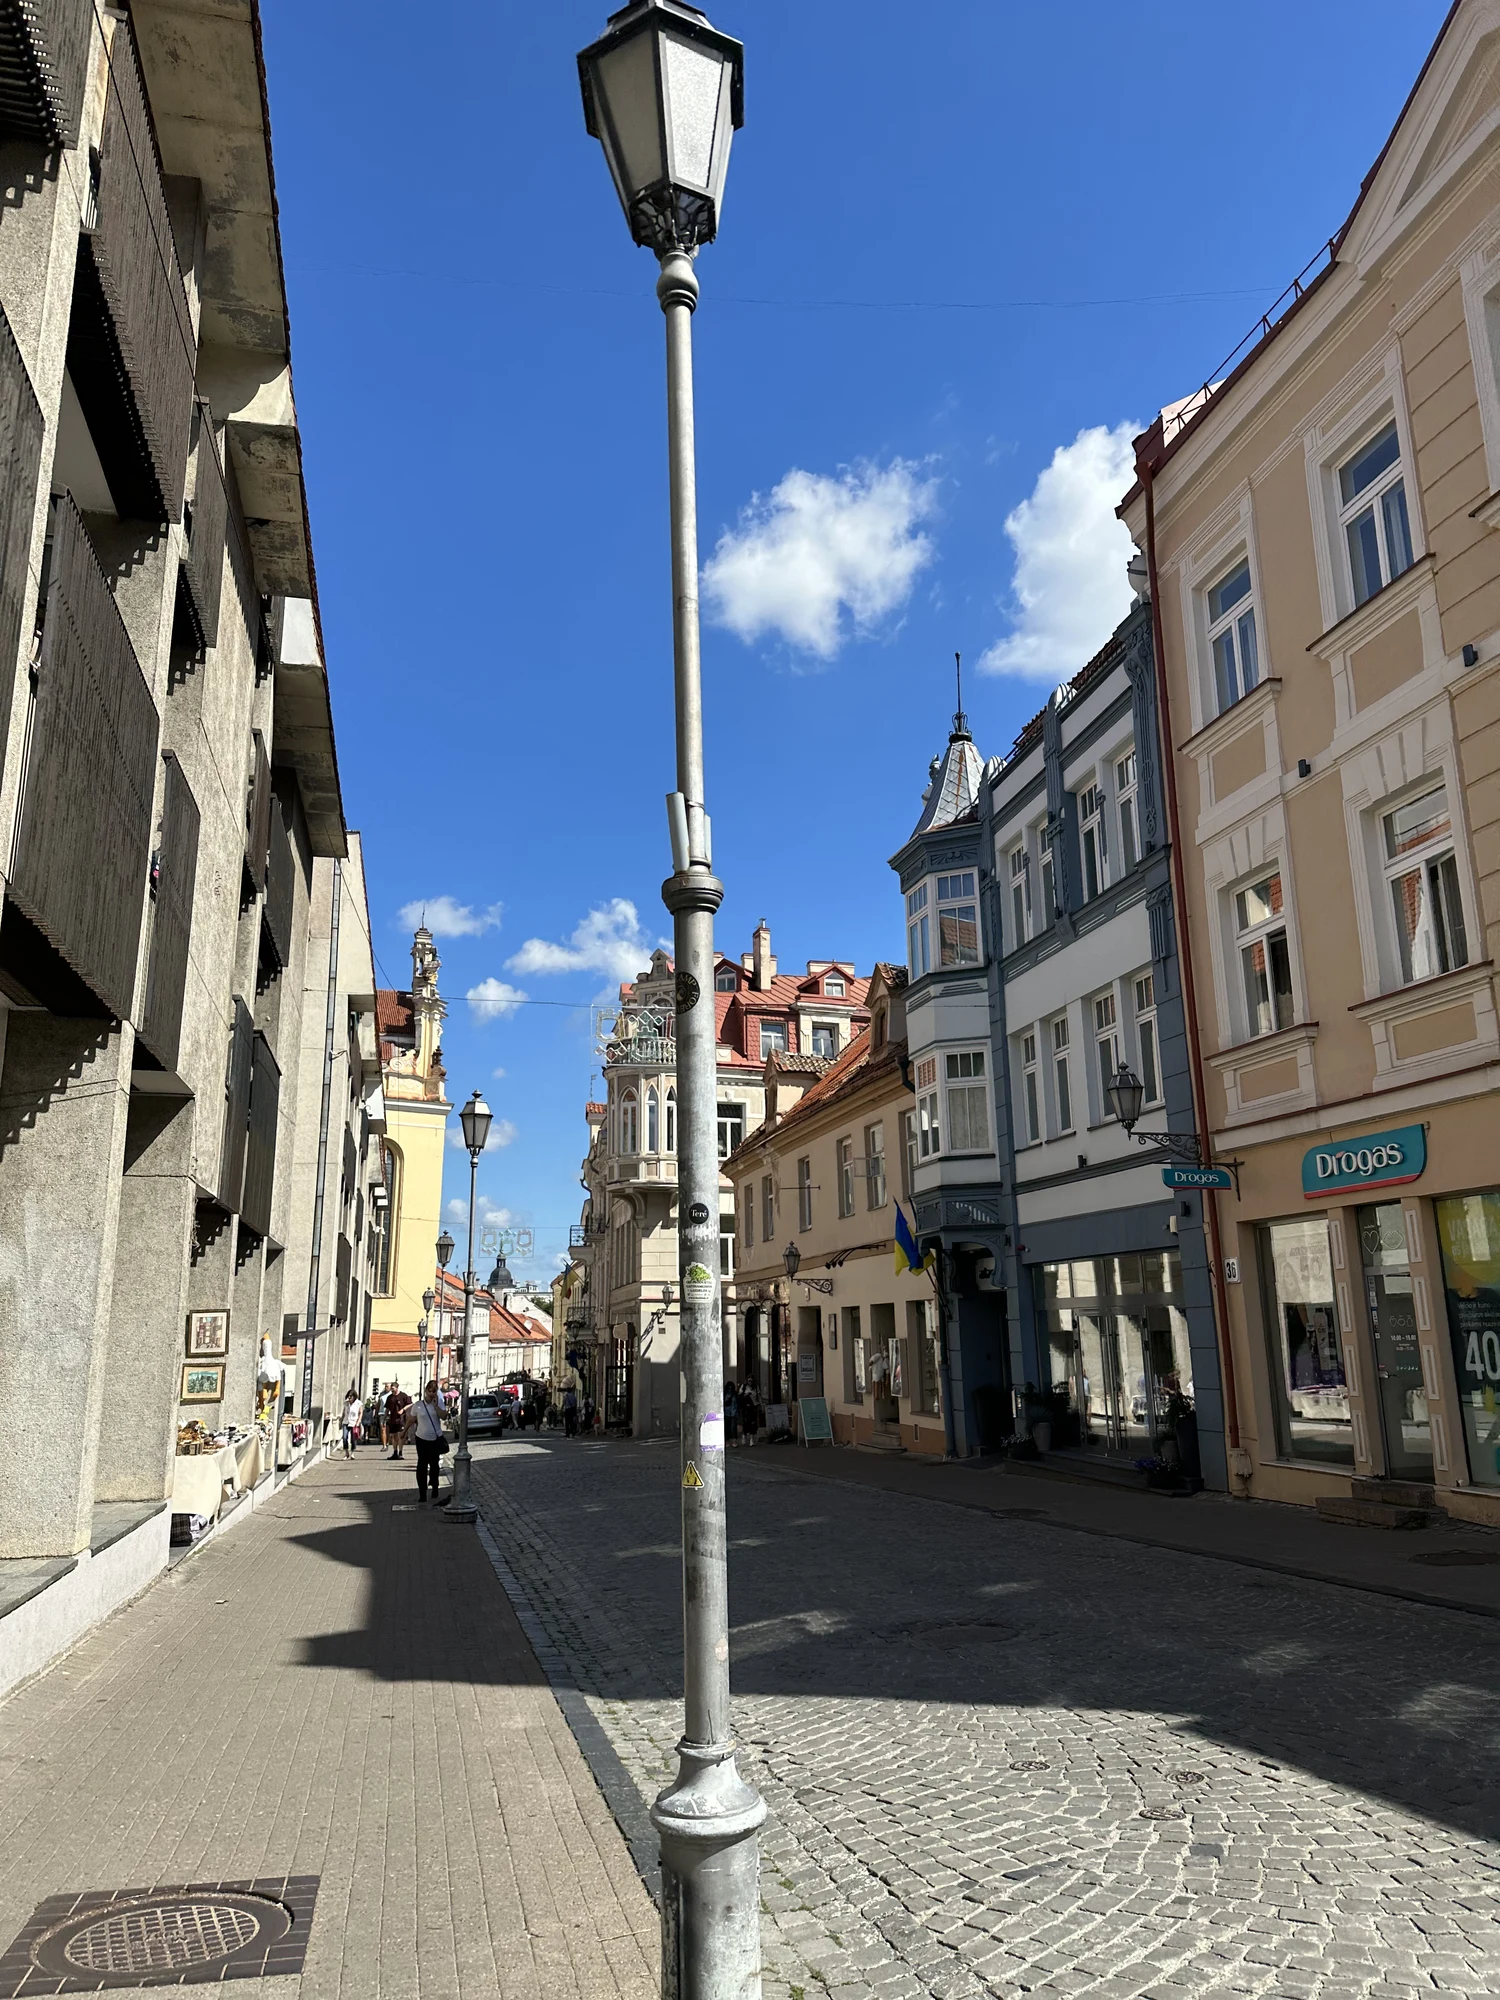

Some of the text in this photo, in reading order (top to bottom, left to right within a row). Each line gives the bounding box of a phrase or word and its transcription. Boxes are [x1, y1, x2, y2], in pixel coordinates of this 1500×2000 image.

[1316, 1143, 1403, 1178] Drogas
[1175, 1171, 1219, 1185] Drogas
[690, 1209, 708, 1218] Teré
[1226, 1261, 1236, 1279] 36
[1465, 1330, 1500, 1381] 40
